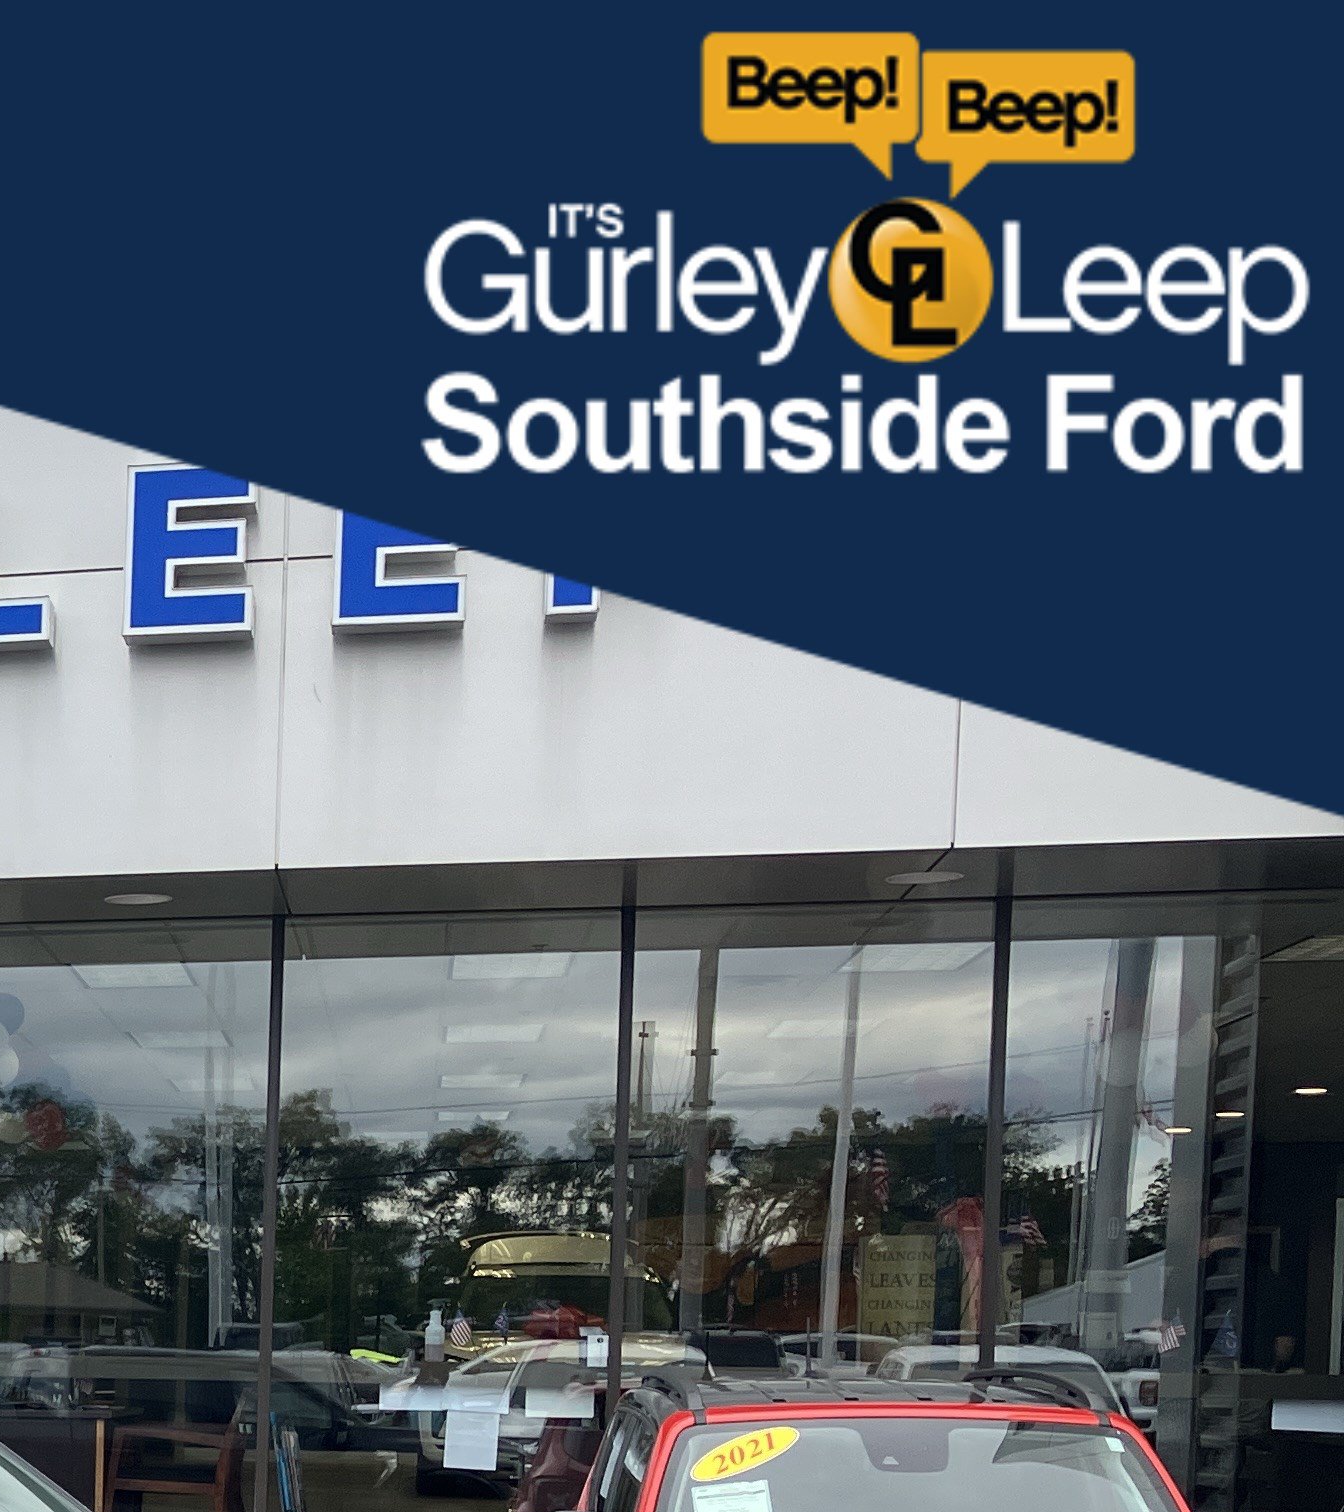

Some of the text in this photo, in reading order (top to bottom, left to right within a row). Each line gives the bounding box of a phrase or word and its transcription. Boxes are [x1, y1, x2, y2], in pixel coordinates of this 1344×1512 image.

[869, 1251, 934, 1262] CHANGIN
[867, 1299, 932, 1310] CHANGIN
[712, 1432, 775, 1475] 2021
